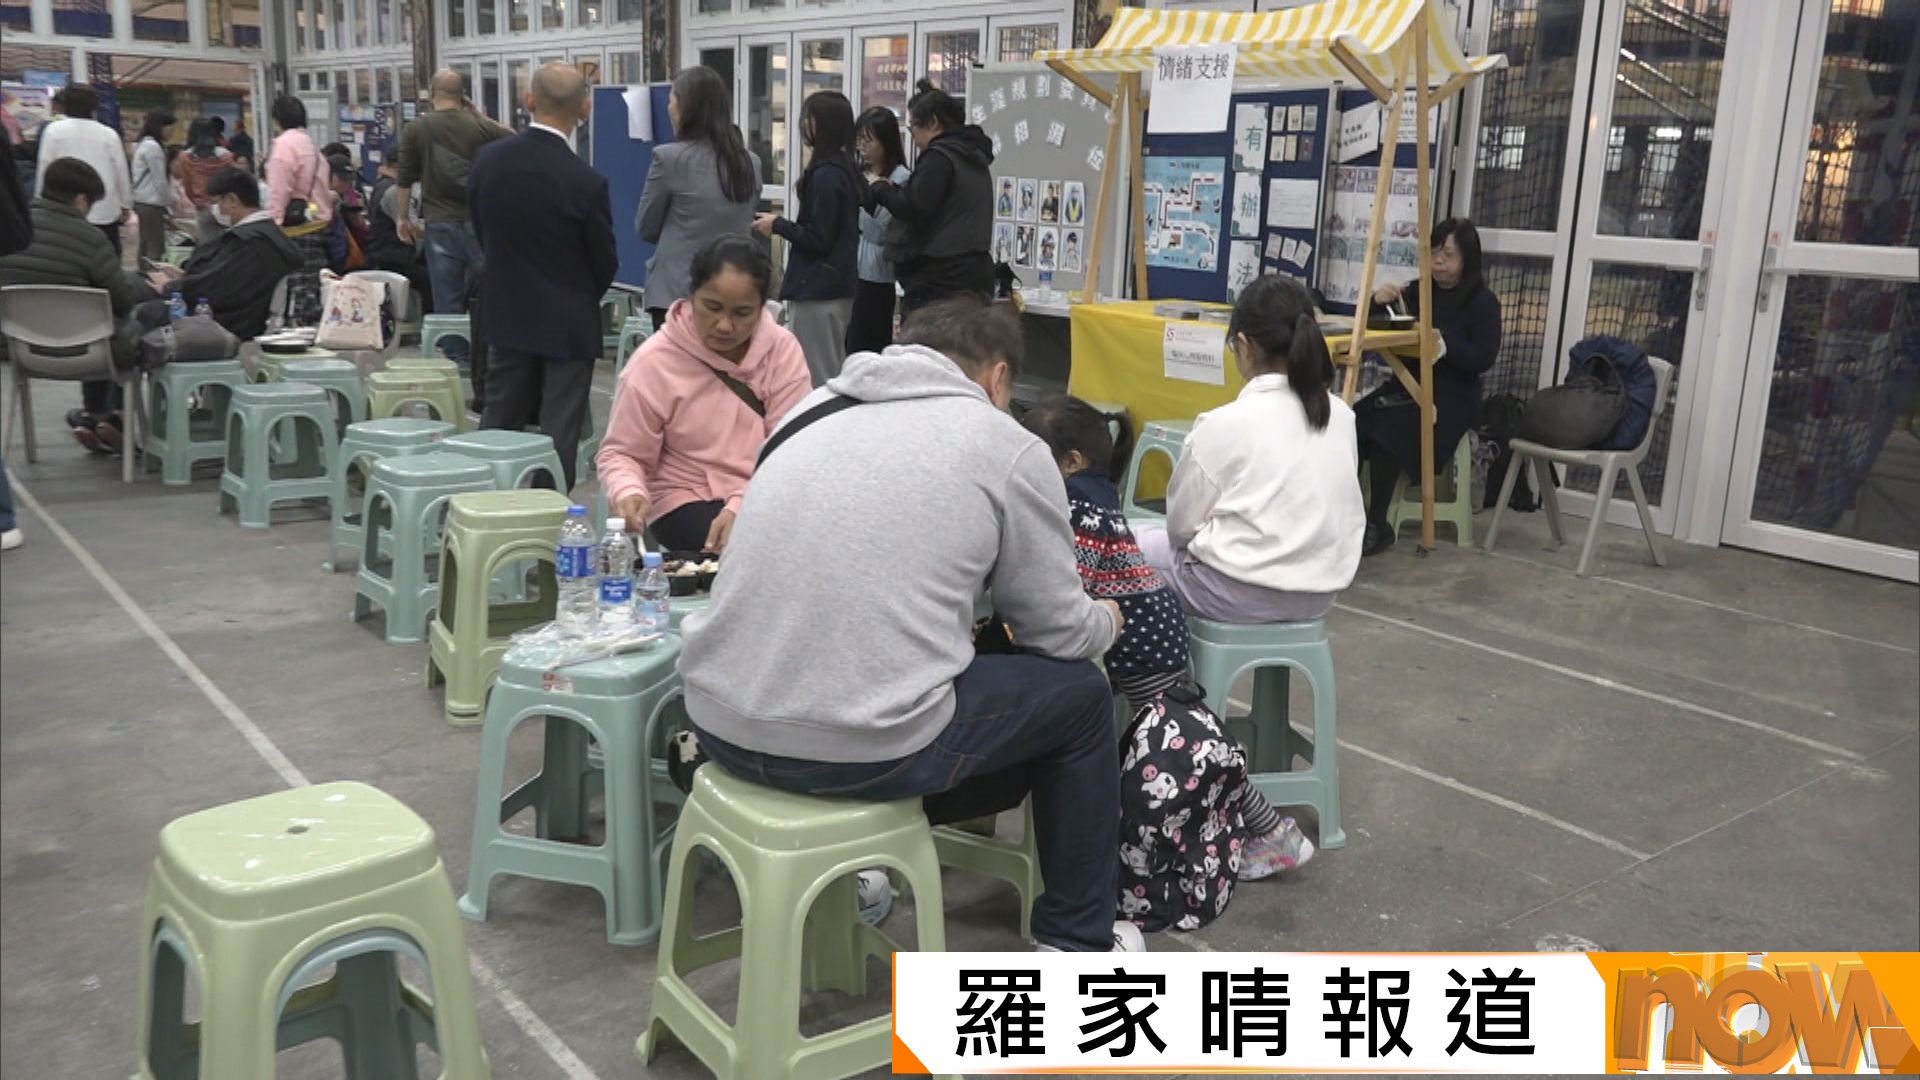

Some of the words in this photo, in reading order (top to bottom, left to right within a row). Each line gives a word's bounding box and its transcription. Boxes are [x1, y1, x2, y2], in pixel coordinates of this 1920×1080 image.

[1158, 53, 1230, 81] 情緒支援
[1235, 125, 1264, 286] 有辦法
